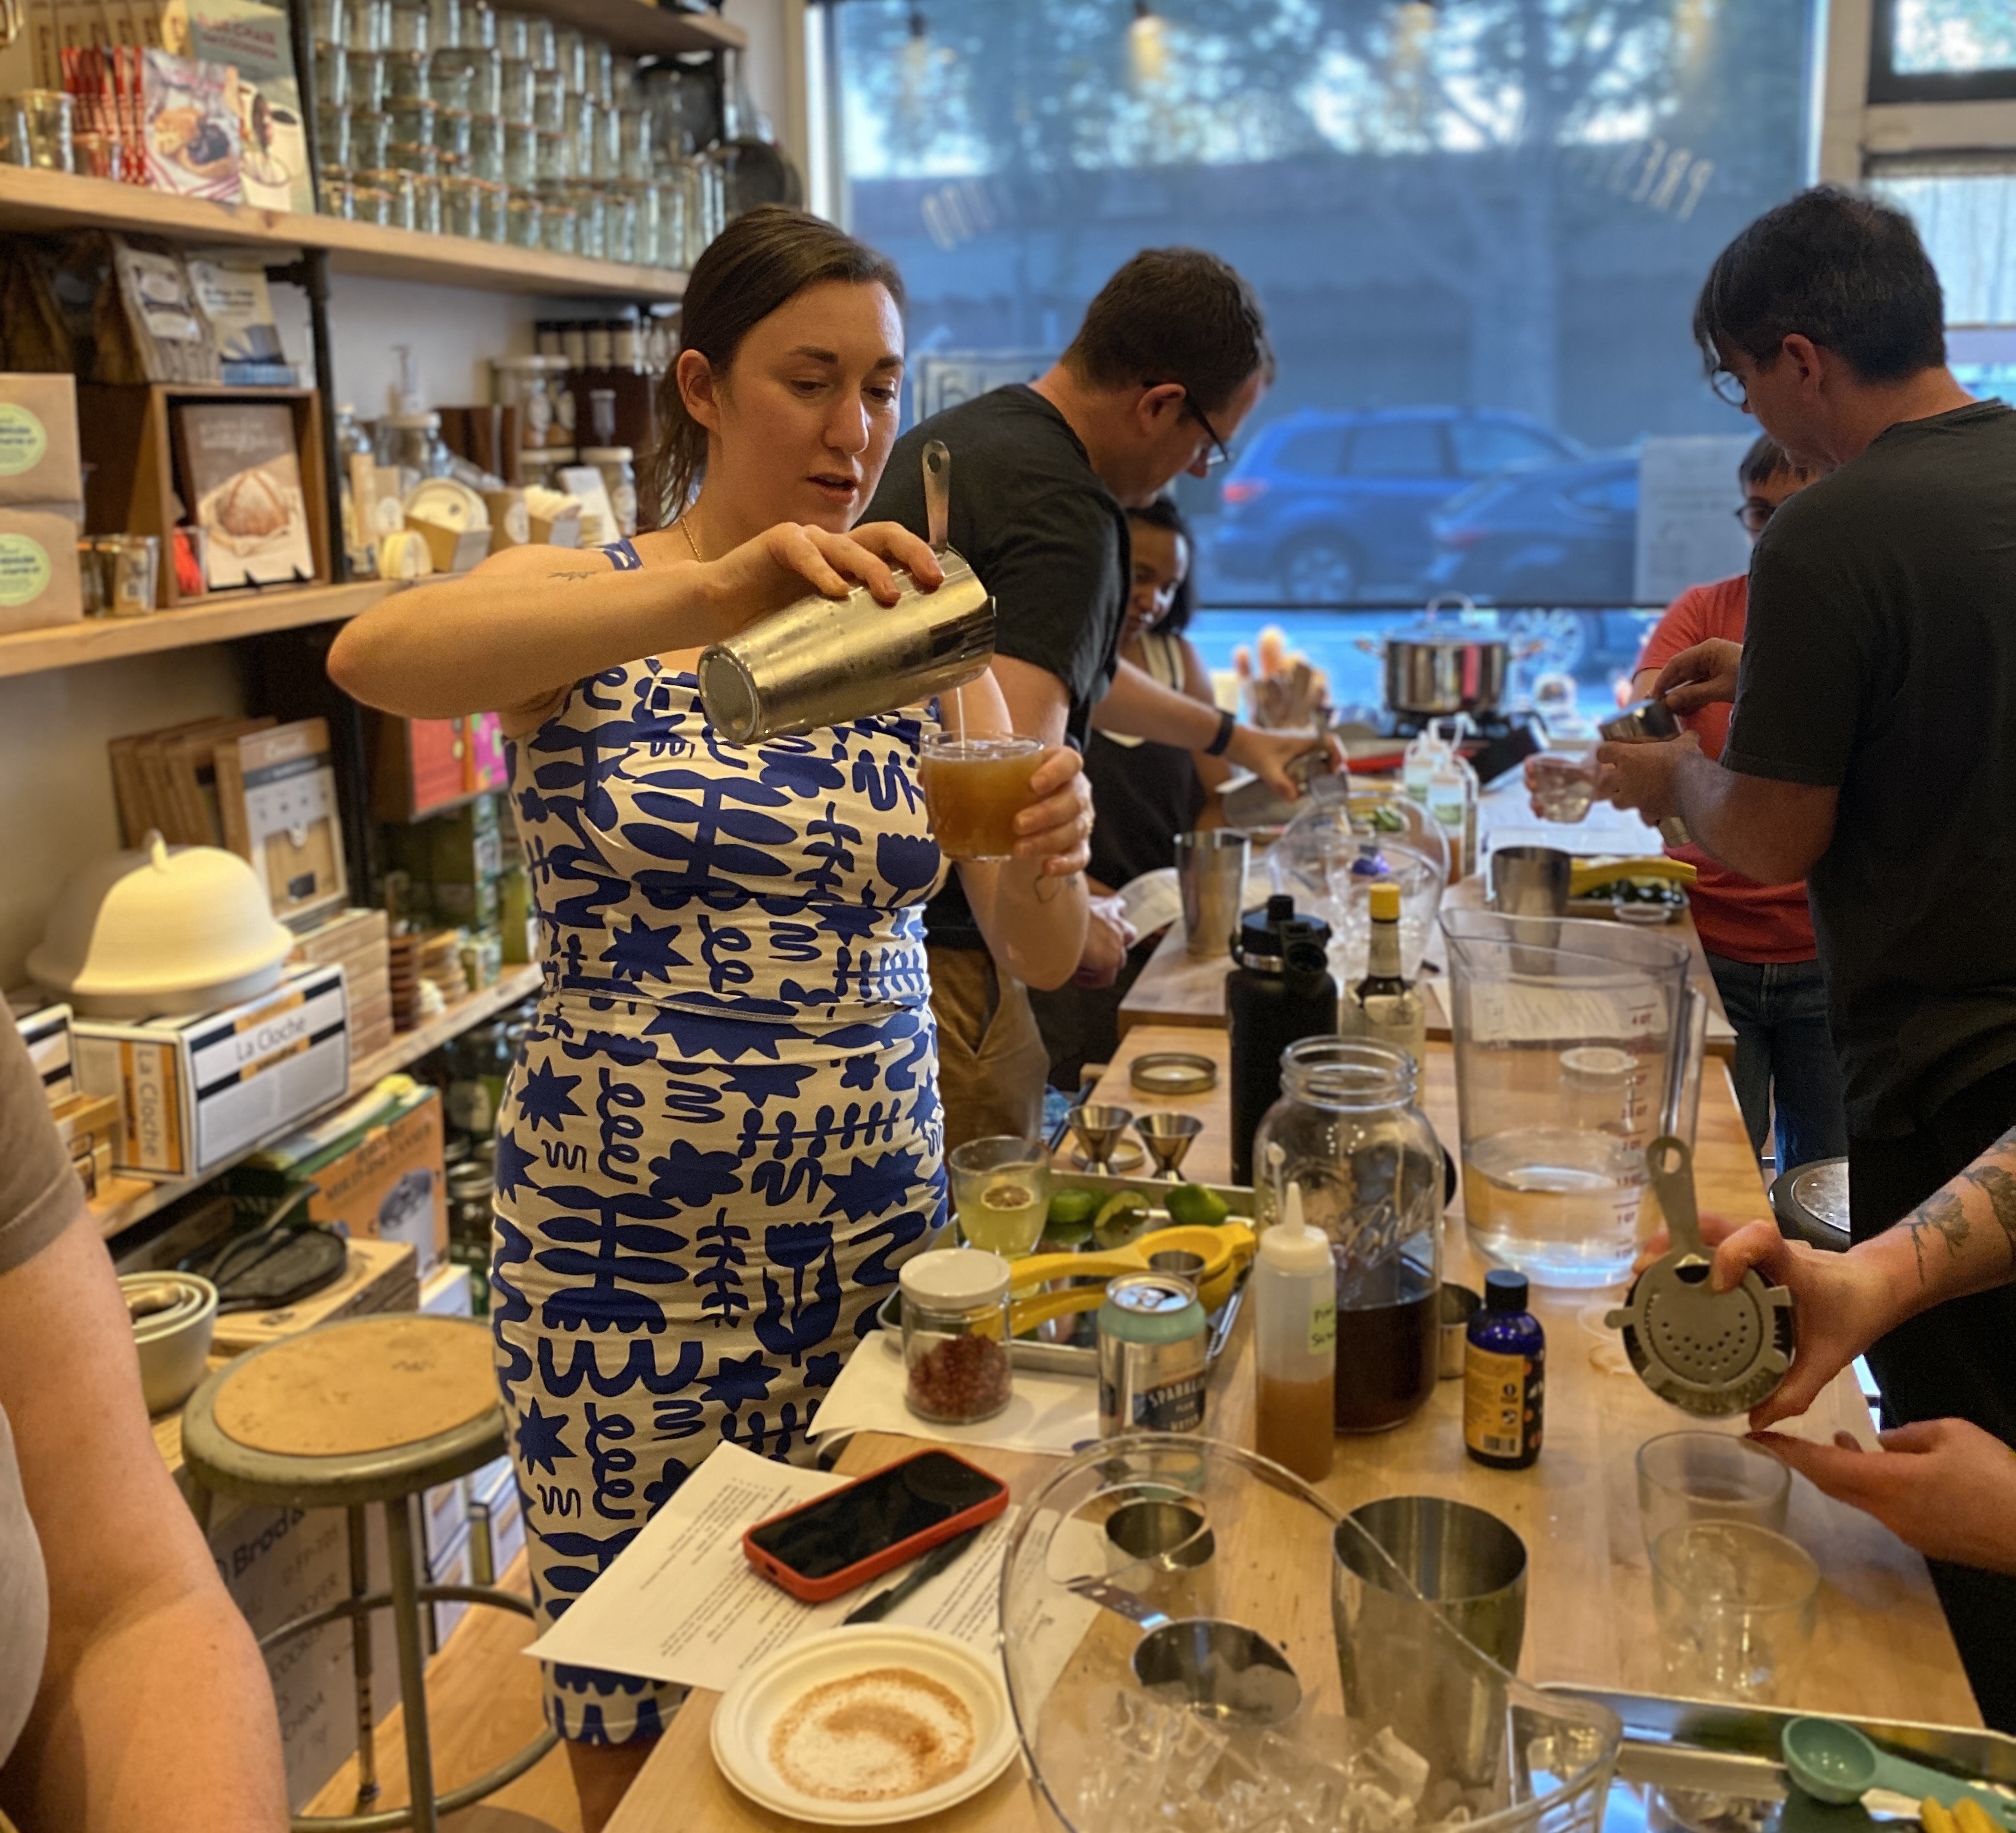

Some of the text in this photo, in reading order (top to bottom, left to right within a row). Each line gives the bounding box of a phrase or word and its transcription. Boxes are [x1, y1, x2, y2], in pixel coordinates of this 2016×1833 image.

[235, 1040, 255, 1062] La
[257, 1016, 306, 1052] Cloche
[137, 1050, 160, 1158] La Cloche
[233, 1506, 287, 1580] Brod
